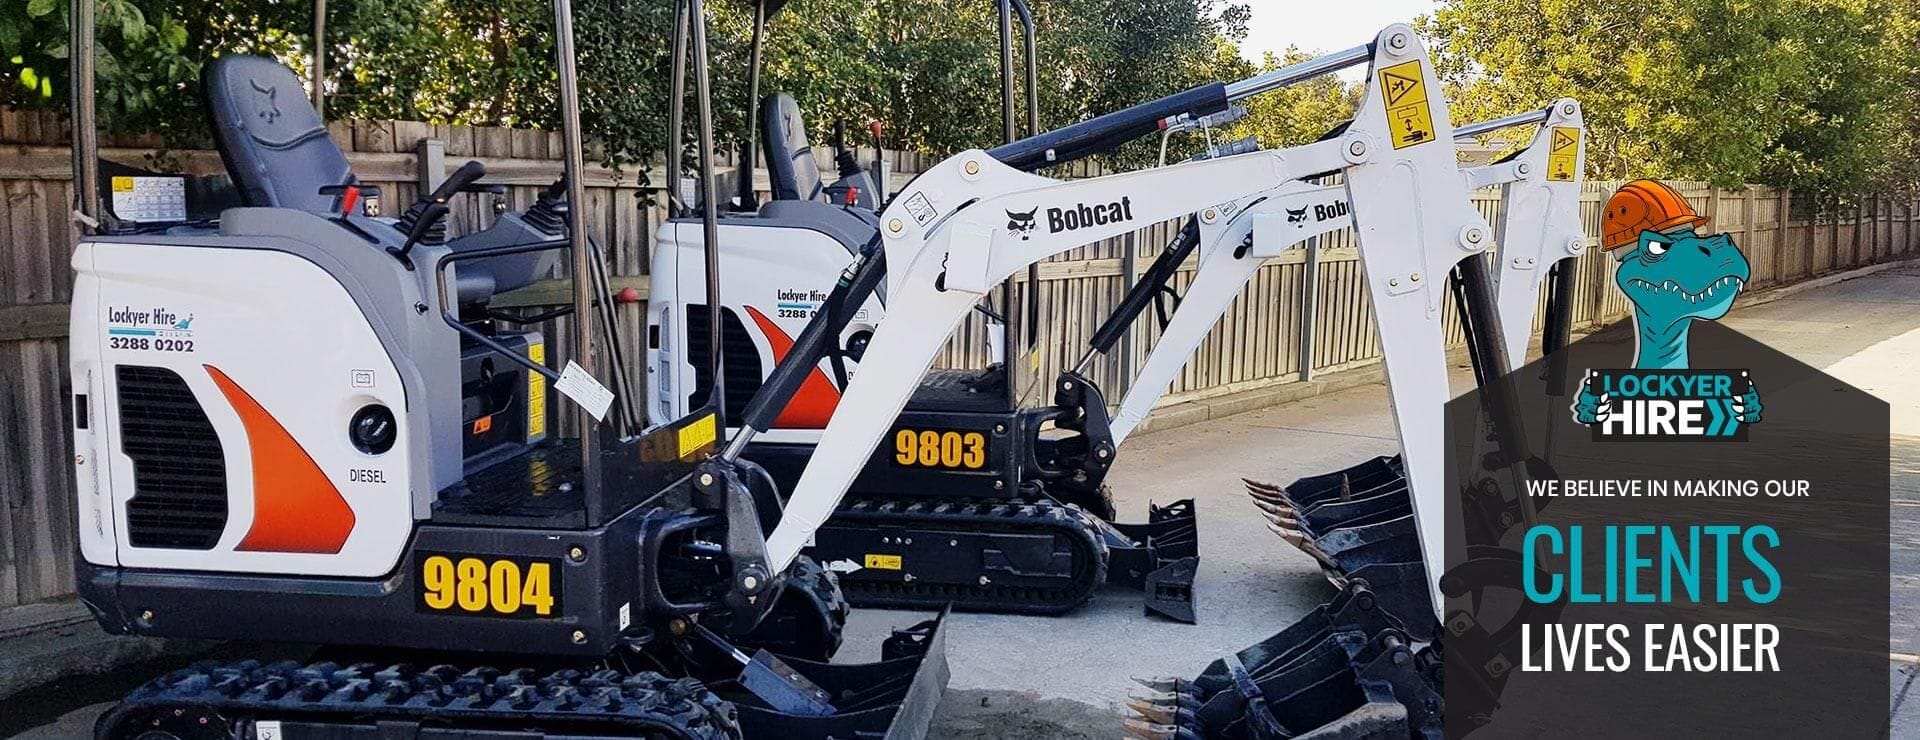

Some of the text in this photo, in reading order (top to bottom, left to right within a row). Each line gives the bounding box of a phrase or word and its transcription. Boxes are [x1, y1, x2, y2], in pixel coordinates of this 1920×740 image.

[1047, 196, 1133, 234] Bobcat
[1314, 200, 1350, 222] Bob
[778, 289, 827, 303] Lockyer Hire
[109, 305, 176, 327] Lockyer Hire
[778, 309, 807, 318] 3288
[110, 337, 194, 352] 3288 0202
[896, 429, 985, 468] 9803
[350, 469, 386, 483] DIESEL
[423, 556, 554, 615] 9804
